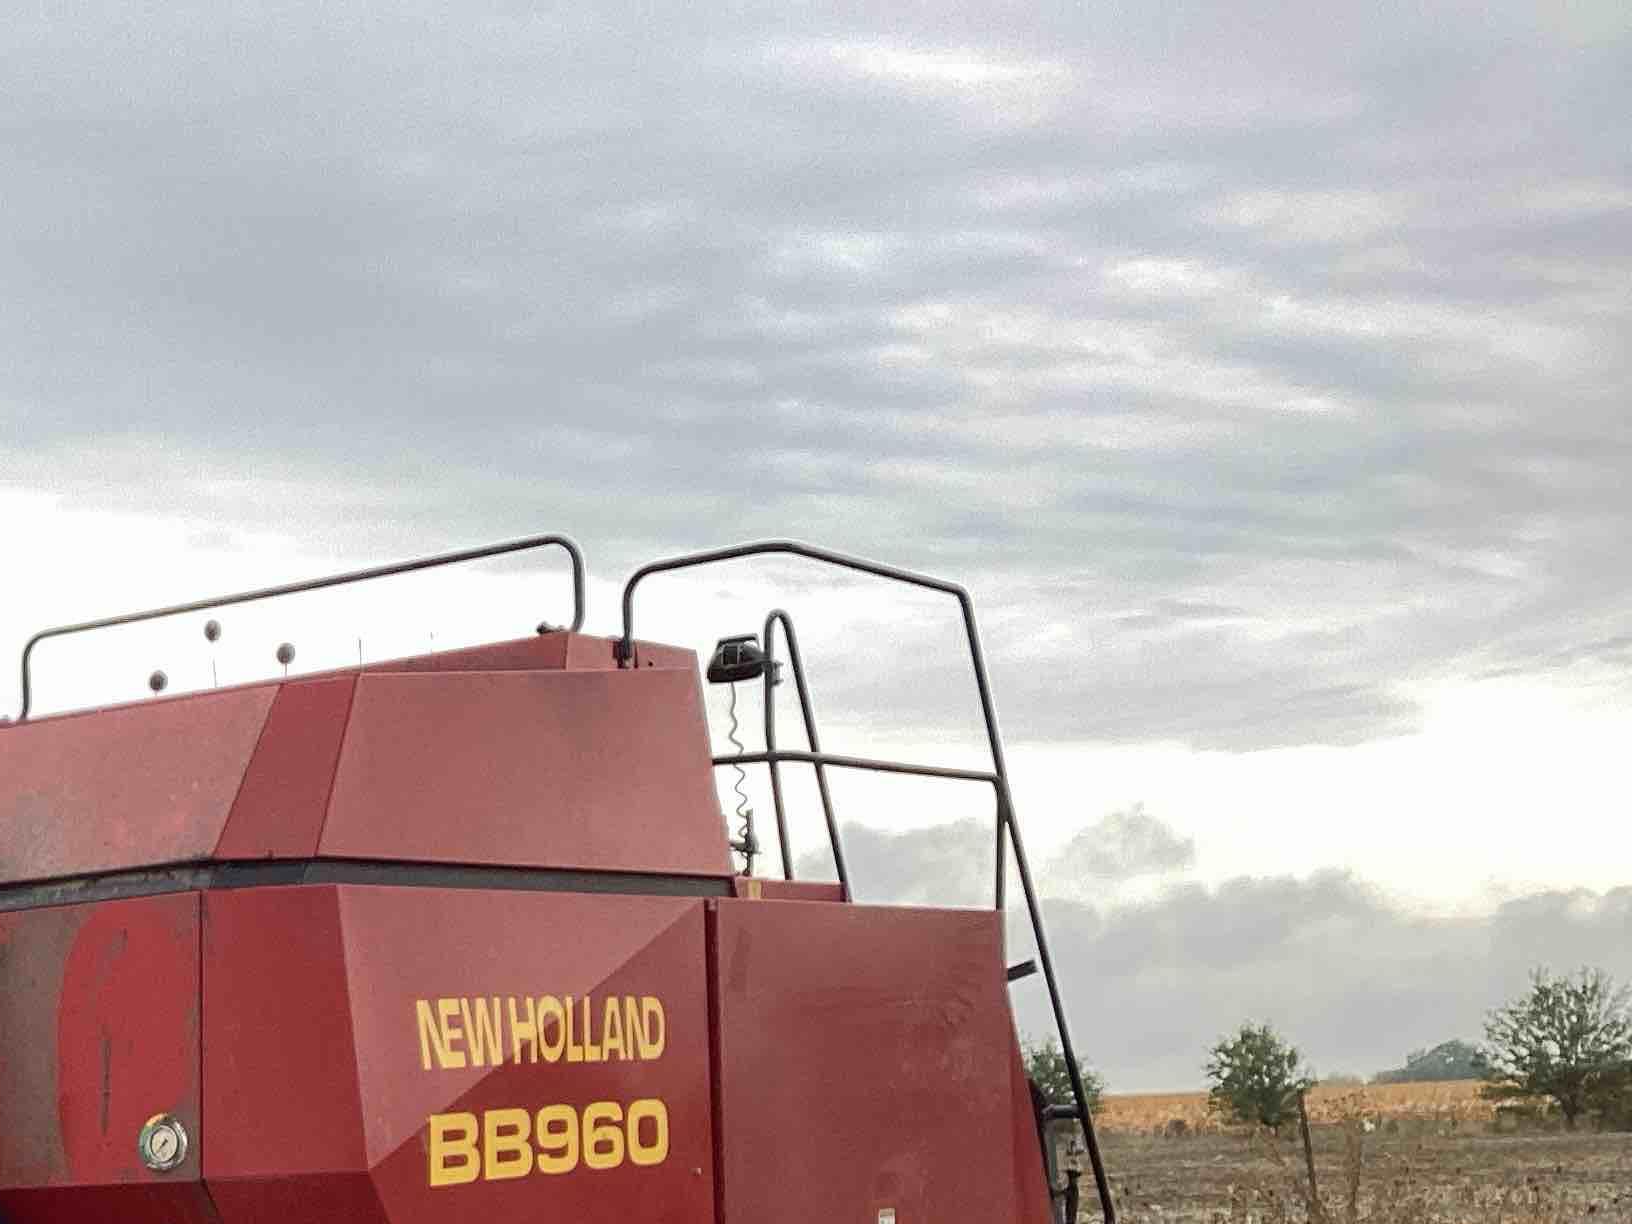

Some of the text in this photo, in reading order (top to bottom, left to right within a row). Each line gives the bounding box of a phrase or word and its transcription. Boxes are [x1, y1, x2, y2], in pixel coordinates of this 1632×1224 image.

[417, 995, 666, 1071] NEW HOLLAND
[428, 1098, 670, 1187] BB960
